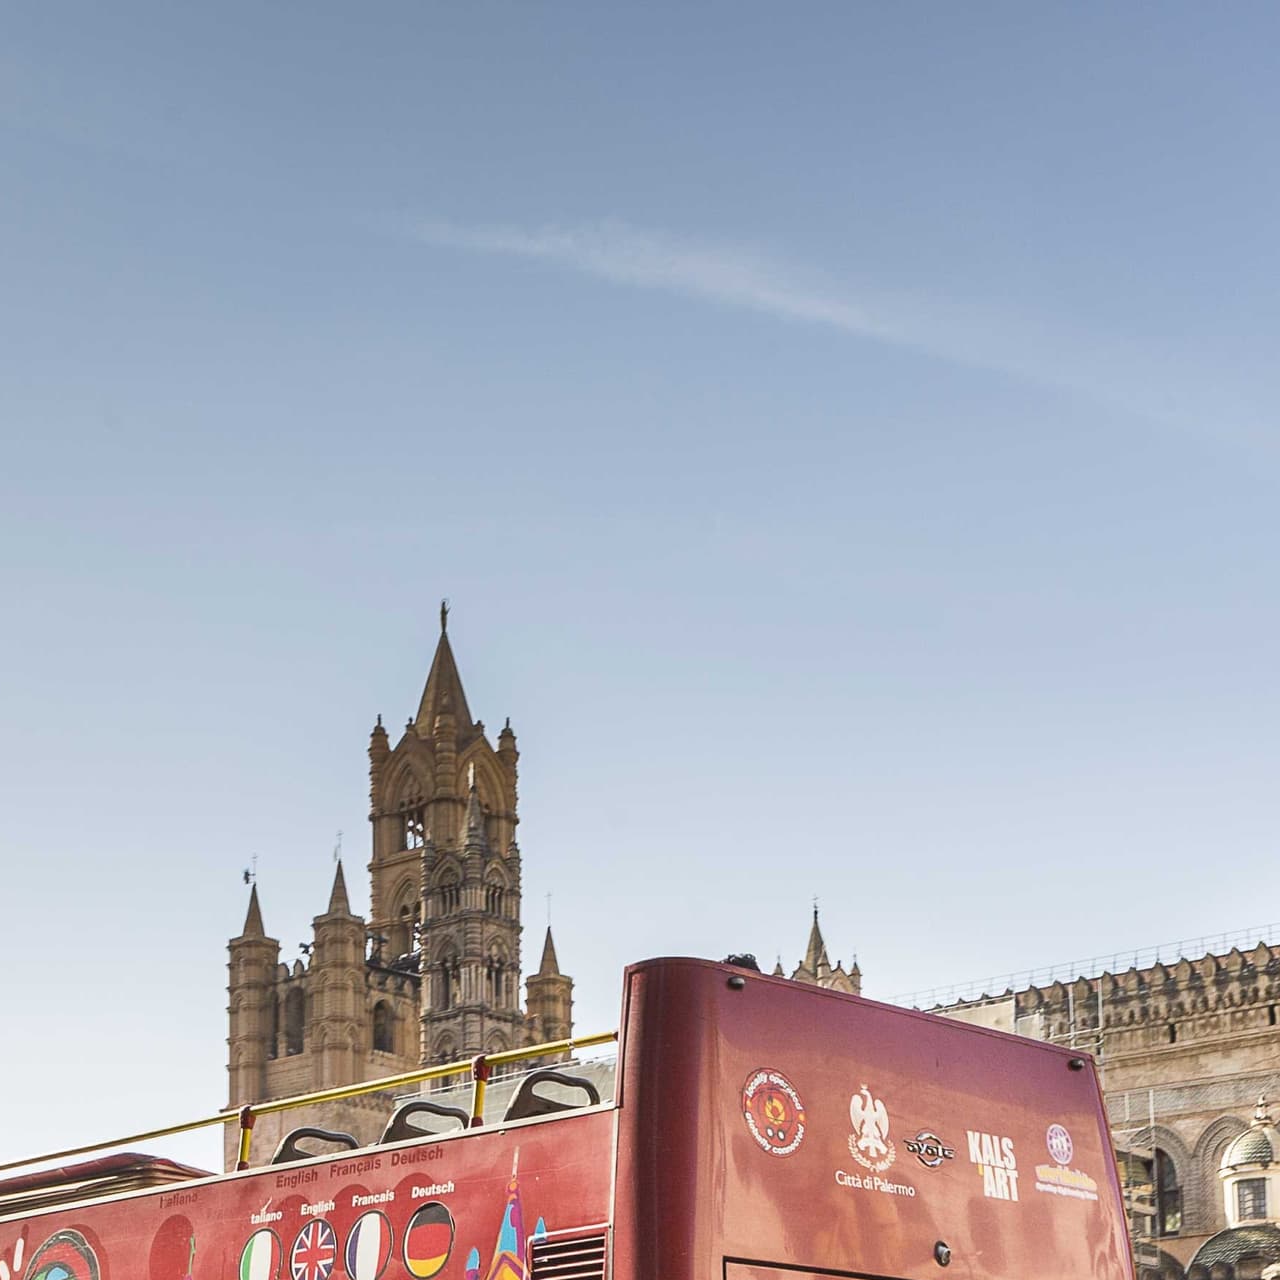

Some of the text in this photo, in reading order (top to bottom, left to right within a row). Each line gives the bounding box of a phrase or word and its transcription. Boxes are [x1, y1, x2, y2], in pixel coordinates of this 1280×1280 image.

[966, 1130, 1017, 1170] KALS
[276, 1146, 443, 1188] English Français Deutsch
[411, 1180, 455, 1199] Deutsch
[835, 1170, 916, 1197] Città di Palermo
[301, 1200, 336, 1217] English
